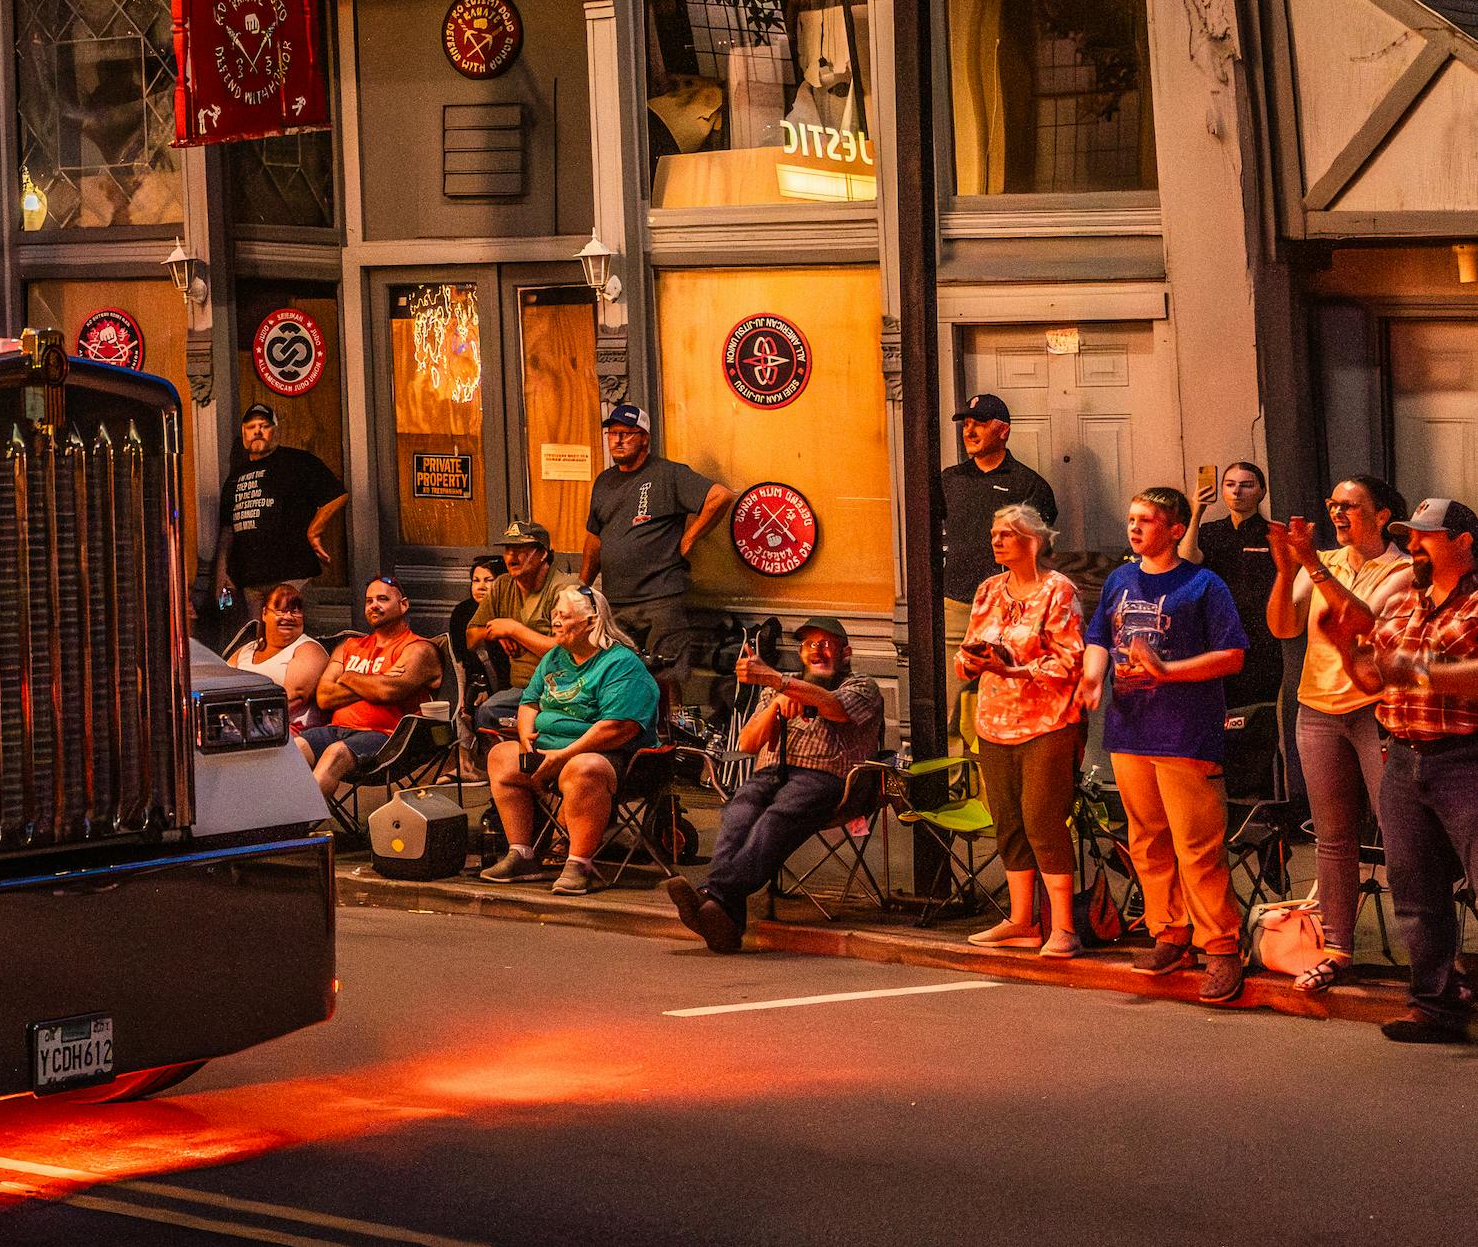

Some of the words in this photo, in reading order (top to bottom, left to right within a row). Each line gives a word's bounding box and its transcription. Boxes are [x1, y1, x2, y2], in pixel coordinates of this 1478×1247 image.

[446, 23, 462, 62] DEFEND
[461, 59, 486, 73] WITH
[258, 325, 270, 343] JUDO
[310, 329, 322, 346] JUDO
[734, 318, 766, 339] JU-JITSU
[766, 317, 802, 346] AMERICAN
[726, 337, 739, 364] UNION
[796, 345, 806, 363] ALL
[264, 372, 292, 393] AMERICAN
[294, 380, 310, 392] JUDO
[308, 361, 322, 383] UNION
[734, 380, 765, 404] JU-JITSU
[766, 393, 784, 404] KAN
[422, 457, 462, 473] PRIVATE
[417, 471, 468, 488] PROPERTY
[759, 487, 783, 498] WITH
[266, 498, 274, 507] UP
[735, 493, 758, 523] HONOR
[784, 491, 812, 527] DEFEND
[736, 539, 759, 566] DOJO
[754, 545, 794, 561] KARATE
[760, 555, 801, 573] SUTEMI
[40, 1039, 112, 1076] YCDH612
